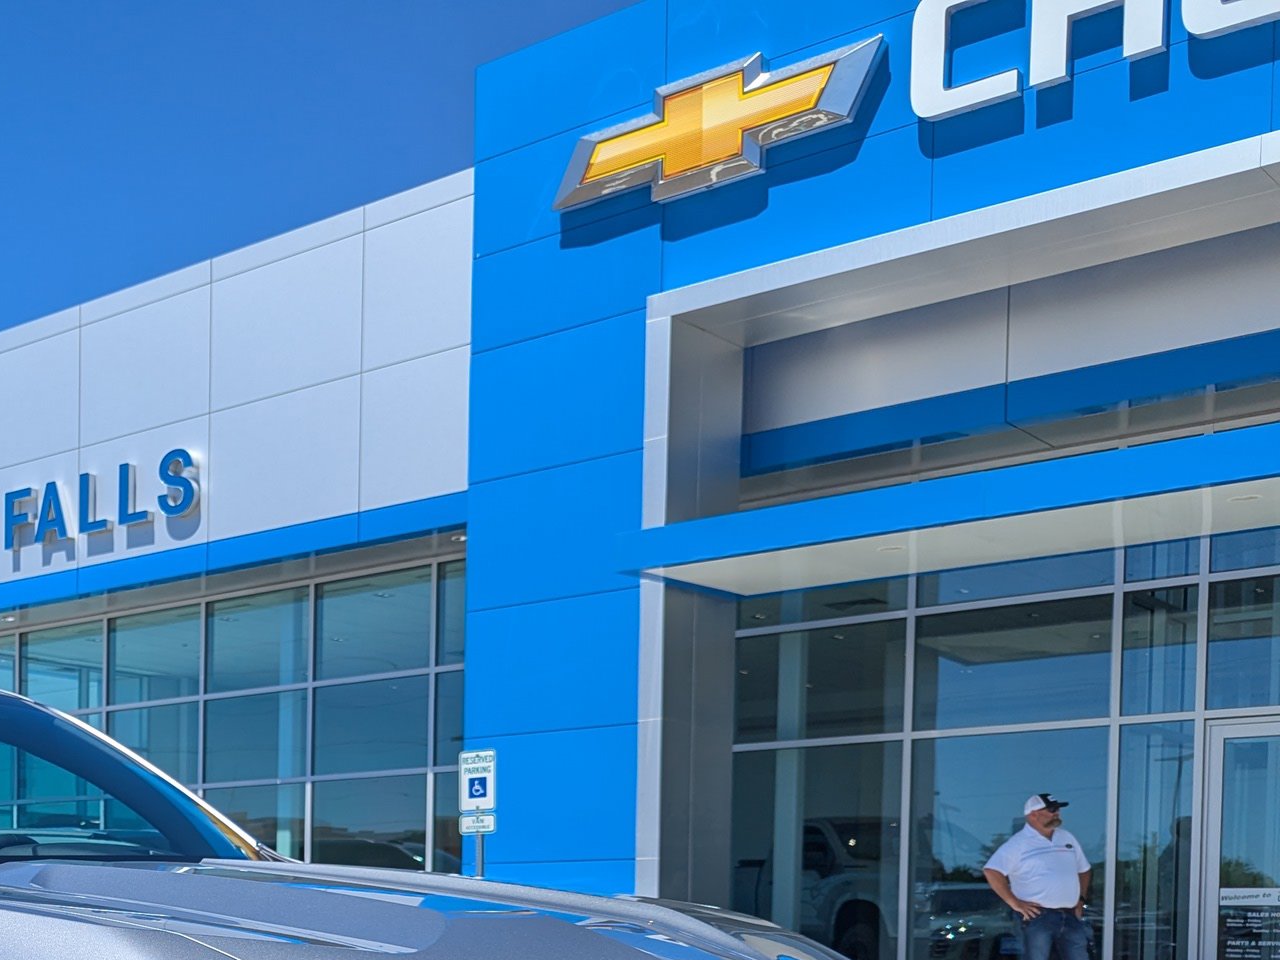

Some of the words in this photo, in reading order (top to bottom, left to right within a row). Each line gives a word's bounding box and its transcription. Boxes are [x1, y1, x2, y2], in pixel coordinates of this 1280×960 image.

[910, 0, 1280, 121] CH
[3, 447, 202, 550] FALLS
[462, 755, 494, 765] RESERVED
[463, 766, 491, 775] PARKING
